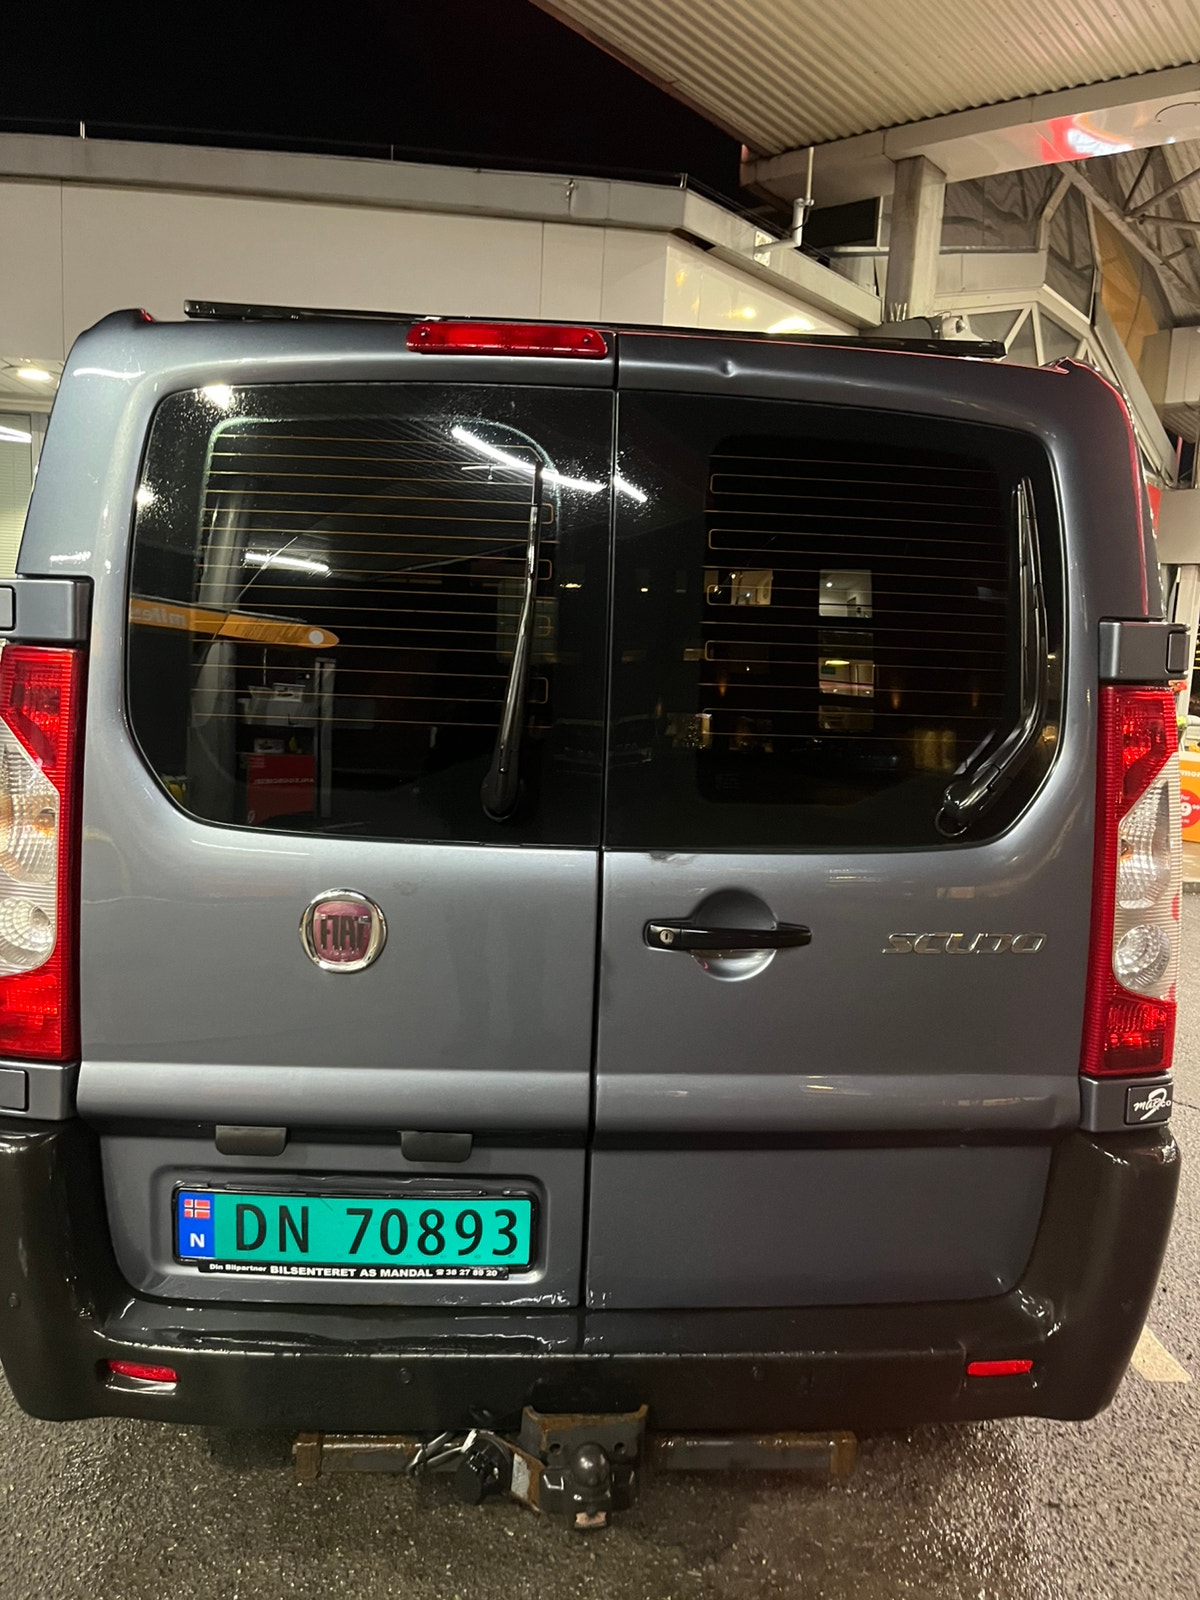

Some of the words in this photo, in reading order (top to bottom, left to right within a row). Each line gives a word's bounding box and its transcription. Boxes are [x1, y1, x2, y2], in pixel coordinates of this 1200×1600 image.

[320, 914, 372, 951] FIAT
[881, 931, 1048, 954] SCUDO
[189, 1232, 206, 1248] N
[235, 1203, 309, 1253] DN
[346, 1207, 518, 1257] 70893
[209, 1263, 224, 1271] Din
[225, 1263, 268, 1272] Bilpartner
[270, 1265, 357, 1277] BILSENTERET
[360, 1268, 378, 1277] AS
[380, 1268, 434, 1278] MANDAL
[459, 1268, 471, 1276] 27
[486, 1269, 498, 1277] 20
